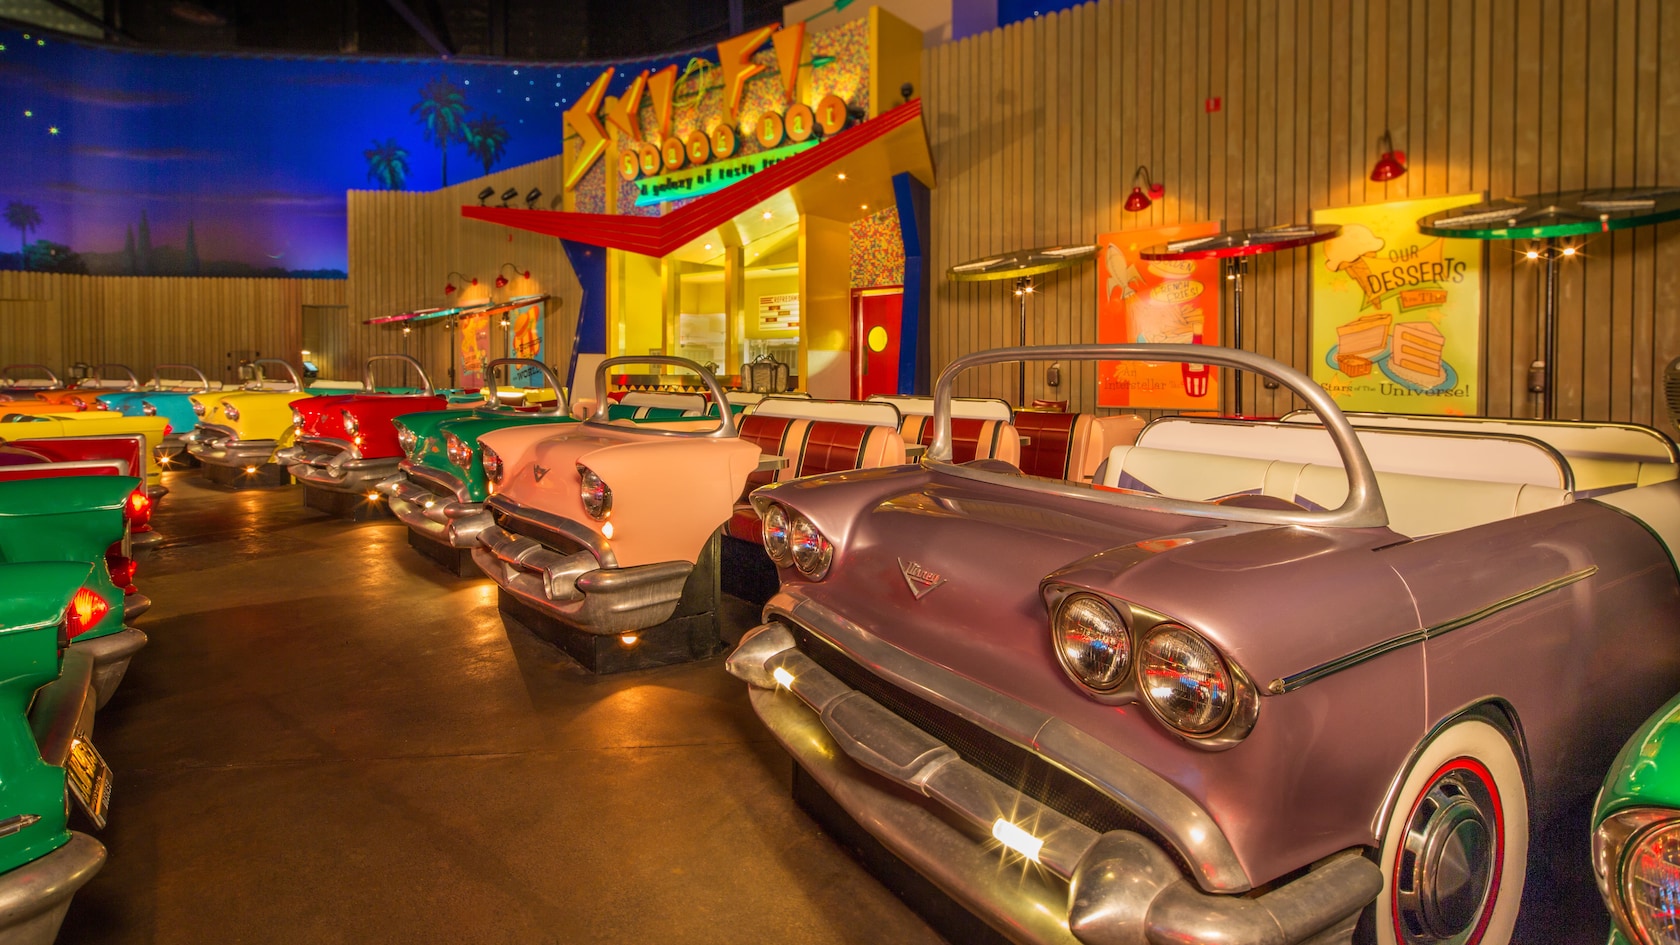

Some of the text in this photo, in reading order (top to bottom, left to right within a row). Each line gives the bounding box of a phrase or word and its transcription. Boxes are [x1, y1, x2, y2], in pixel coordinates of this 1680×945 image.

[653, 176, 693, 197] galaxy
[697, 168, 712, 184] of
[1388, 244, 1420, 263] OUR
[1366, 257, 1467, 295] DESSERTS
[1320, 383, 1352, 393] Stars
[1380, 383, 1470, 398] Universe!
